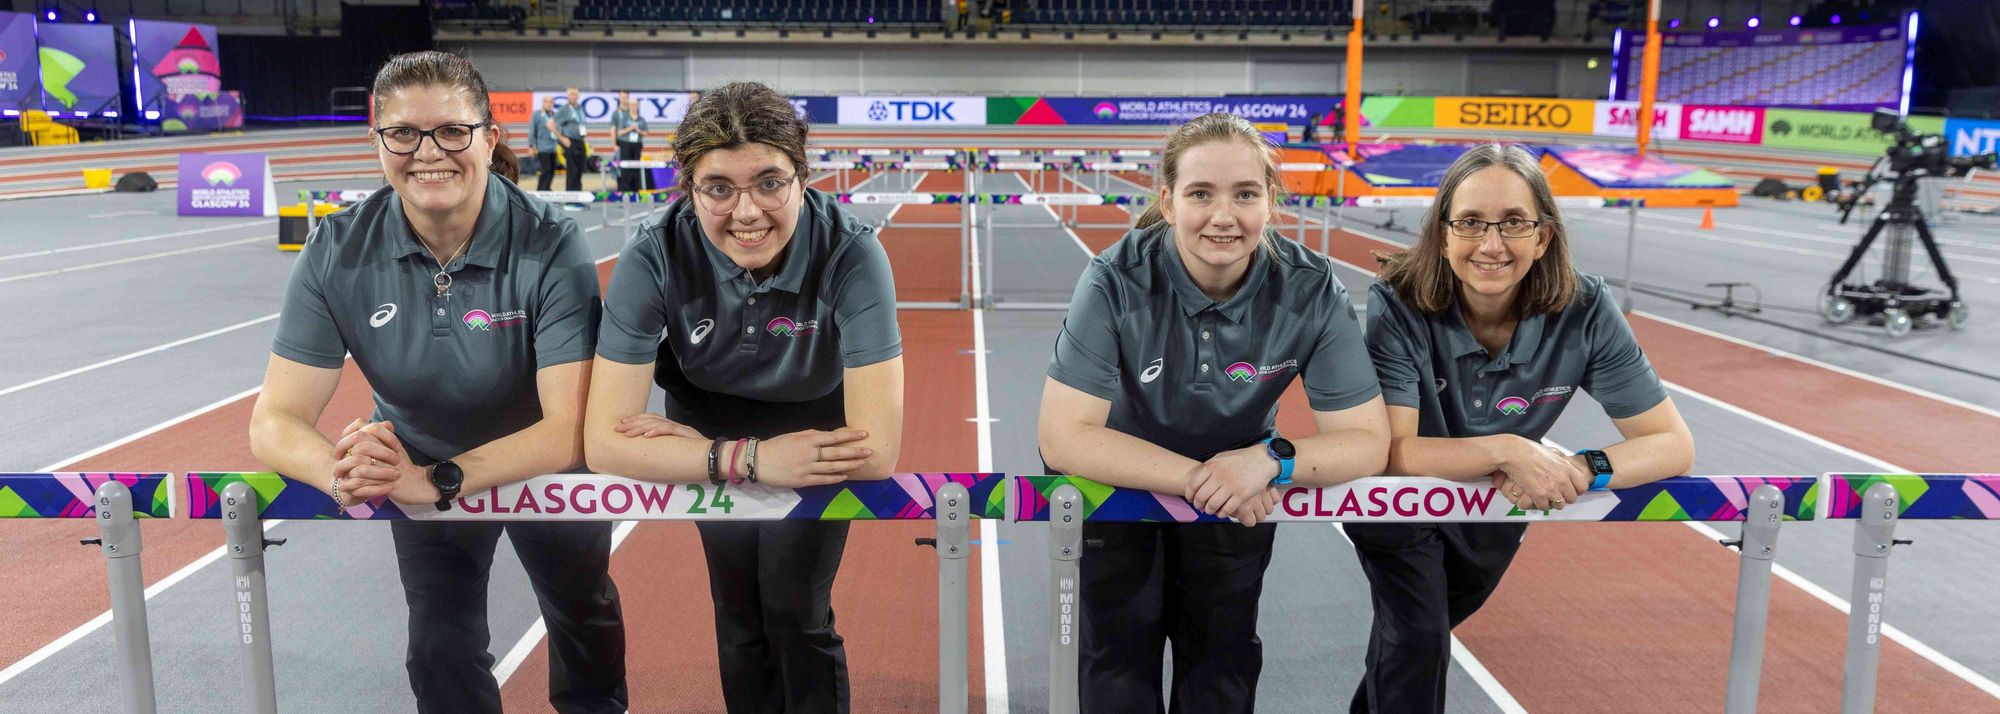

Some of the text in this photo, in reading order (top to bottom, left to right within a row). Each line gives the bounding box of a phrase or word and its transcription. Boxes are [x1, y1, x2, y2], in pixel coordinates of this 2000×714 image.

[489, 102, 527, 114] ETICS
[888, 101, 955, 121] TDK
[1119, 101, 1212, 113] WORLD ATHLETICS
[1213, 103, 1307, 118] GLASGOW 24
[1460, 102, 1571, 128] SEIKO
[1608, 107, 1668, 127] SAH
[1688, 108, 1756, 136] SAMH
[1799, 124, 1852, 140] WORLD
[191, 200, 238, 209] GLASGOW
[457, 484, 734, 514] GLASGOW 24
[1282, 487, 1497, 517] GLASGOW
[237, 591, 253, 645] MONDO
[1059, 593, 1073, 645] MONDO
[1866, 592, 1883, 645] MONDO
